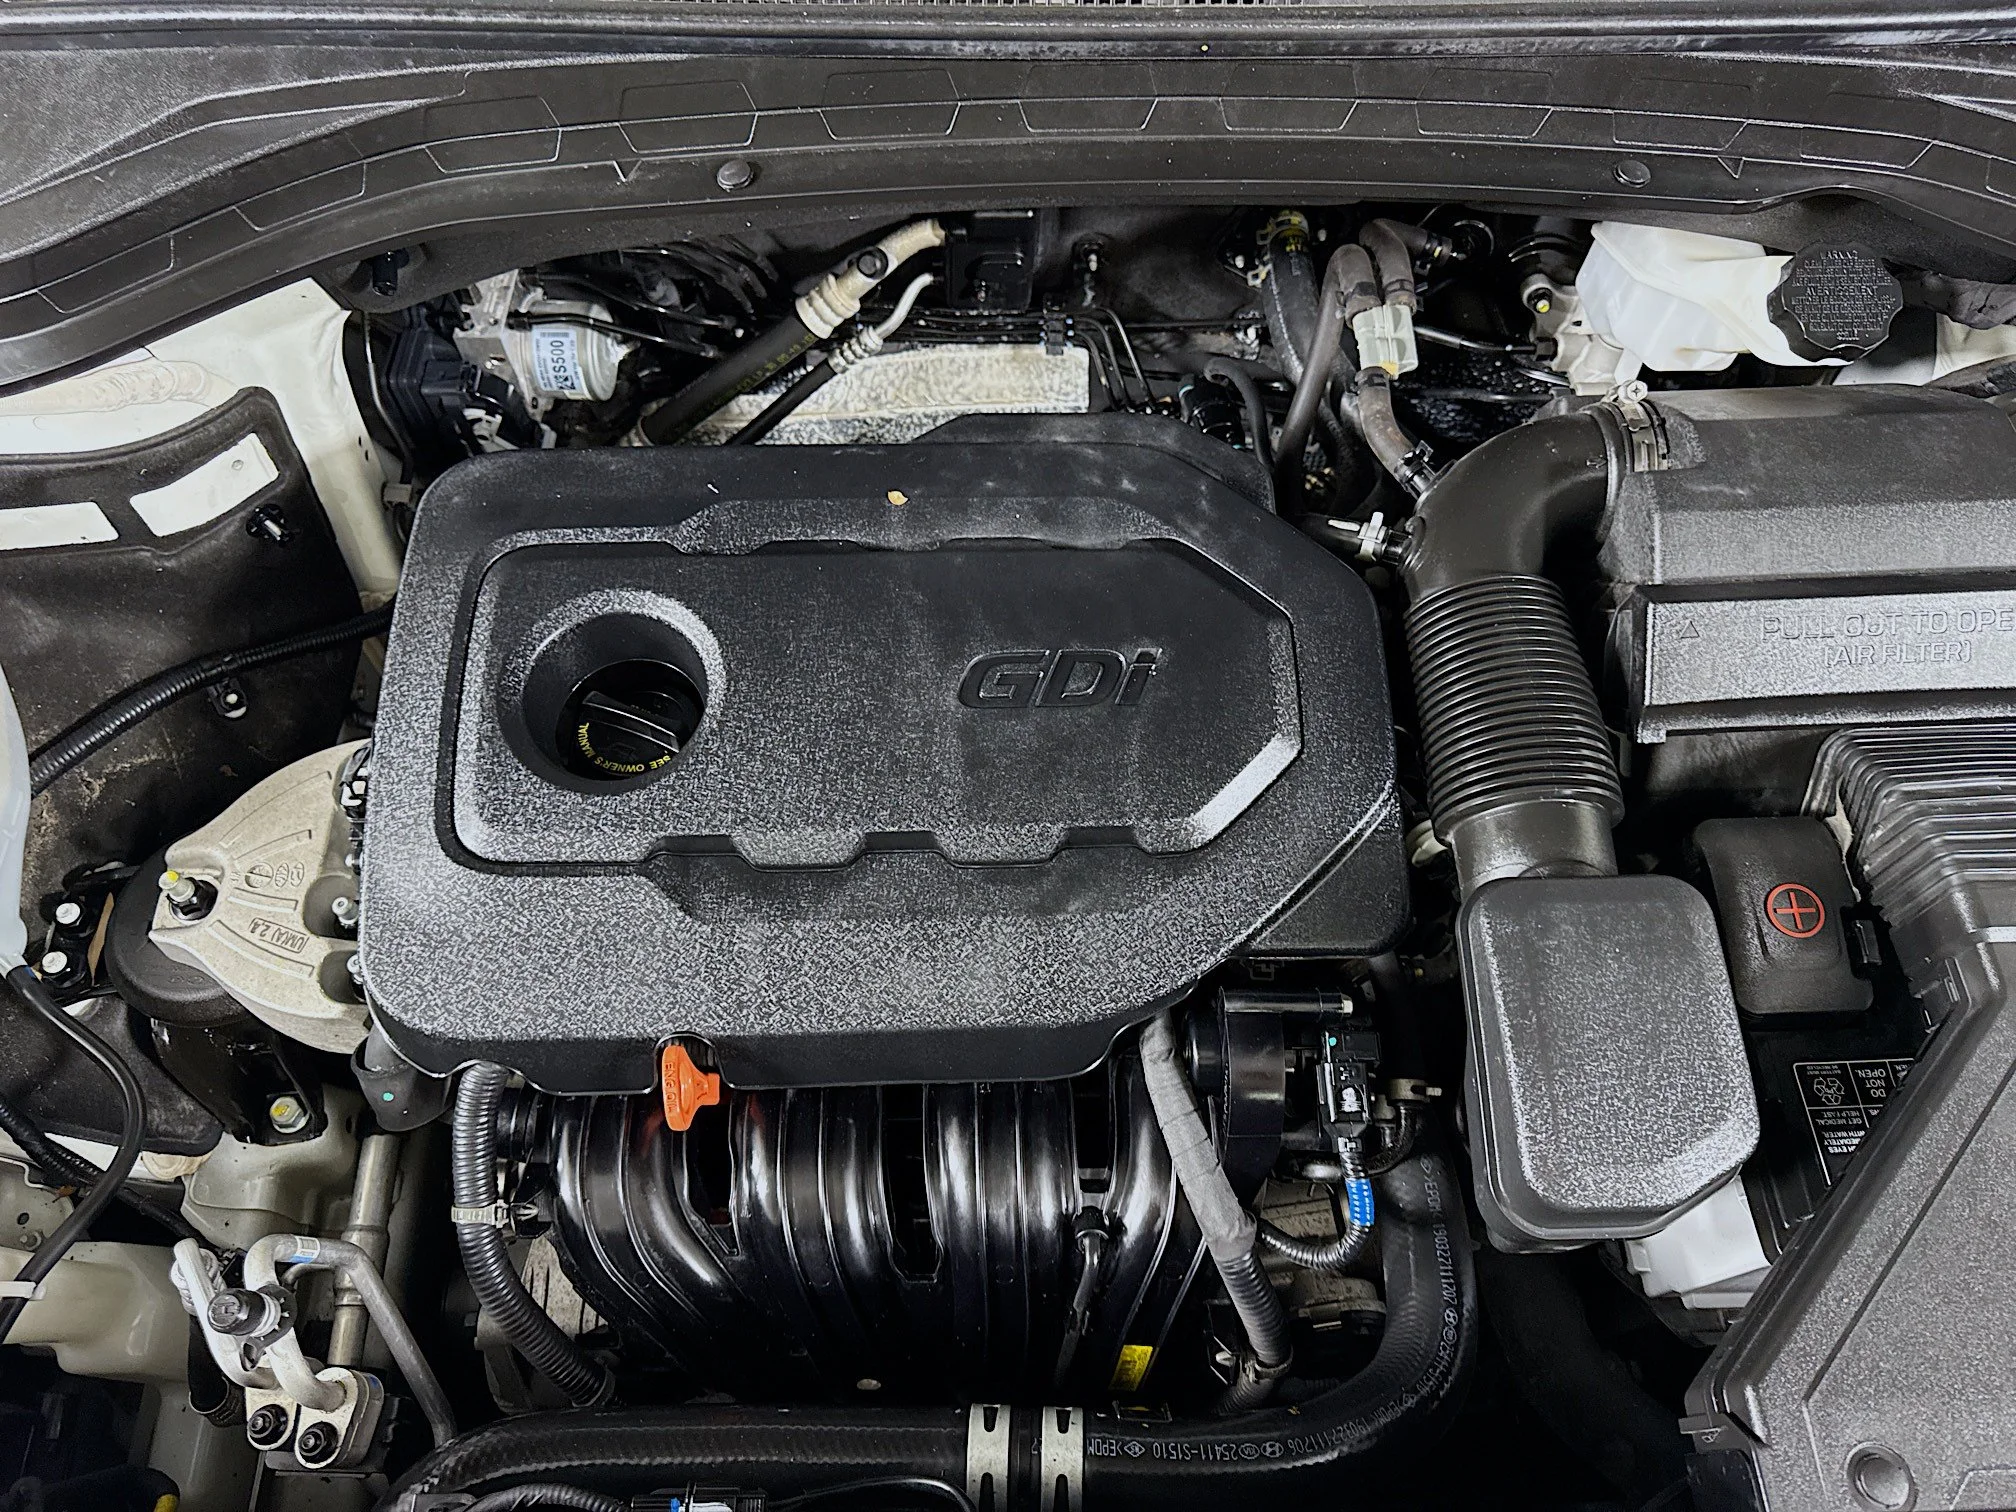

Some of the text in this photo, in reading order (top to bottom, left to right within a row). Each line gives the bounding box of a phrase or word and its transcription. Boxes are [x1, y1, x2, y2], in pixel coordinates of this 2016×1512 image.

[549, 339, 567, 374] S500
[1760, 607, 2016, 641] PULL OUT TO OPE
[957, 648, 1163, 709] GDi
[577, 722, 672, 773] SEE OWNER'S MANUAL
[665, 1061, 676, 1089] ENG
[1855, 1068, 1887, 1078] OPEN.
[1865, 1078, 1886, 1088] NOT
[1870, 1088, 1887, 1098] DO
[1840, 1110, 1860, 1118] HELP
[1815, 1117, 1863, 1126] GET MEDICAL
[1828, 1145, 1848, 1153] EYES
[1152, 1442, 1239, 1461] 25411-S1510
